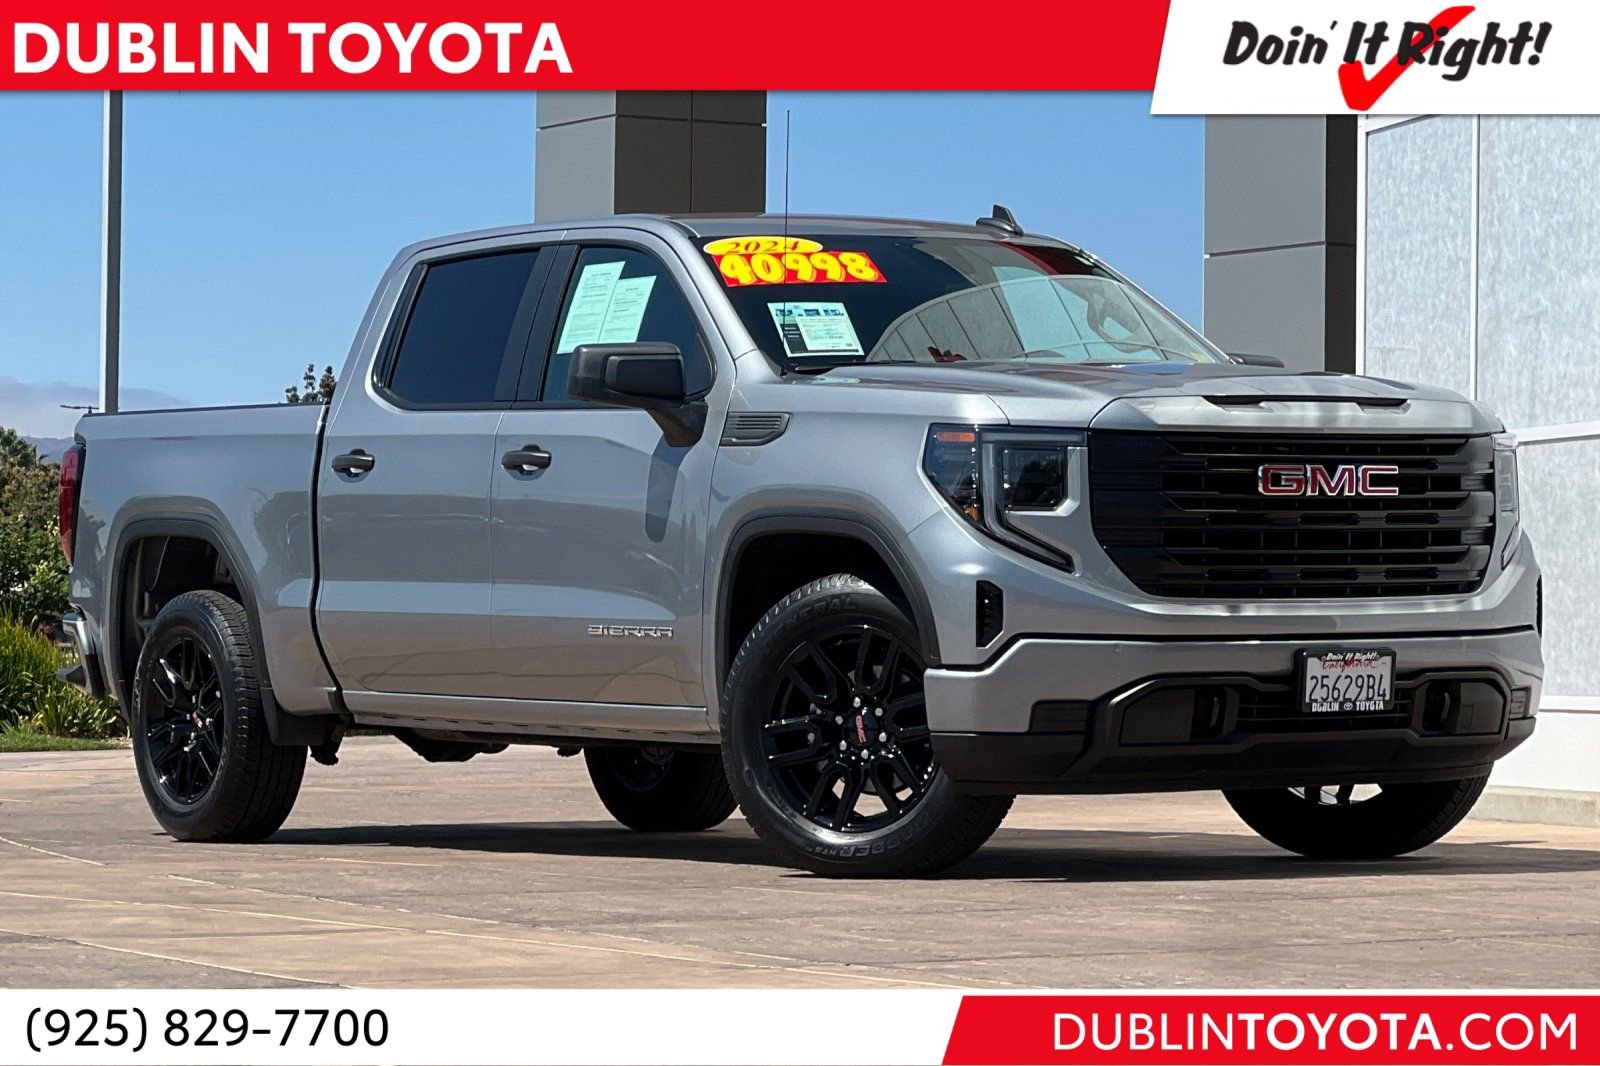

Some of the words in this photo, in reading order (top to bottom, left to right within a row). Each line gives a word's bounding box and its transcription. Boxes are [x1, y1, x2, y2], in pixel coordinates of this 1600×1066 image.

[724, 240, 800, 253] 2024
[1258, 464, 1399, 496] GMC
[588, 624, 673, 637] SIERRA
[1309, 674, 1387, 702] 25629B4
[1312, 701, 1339, 712] DUBLIN
[1356, 700, 1384, 711] TOYOTA
